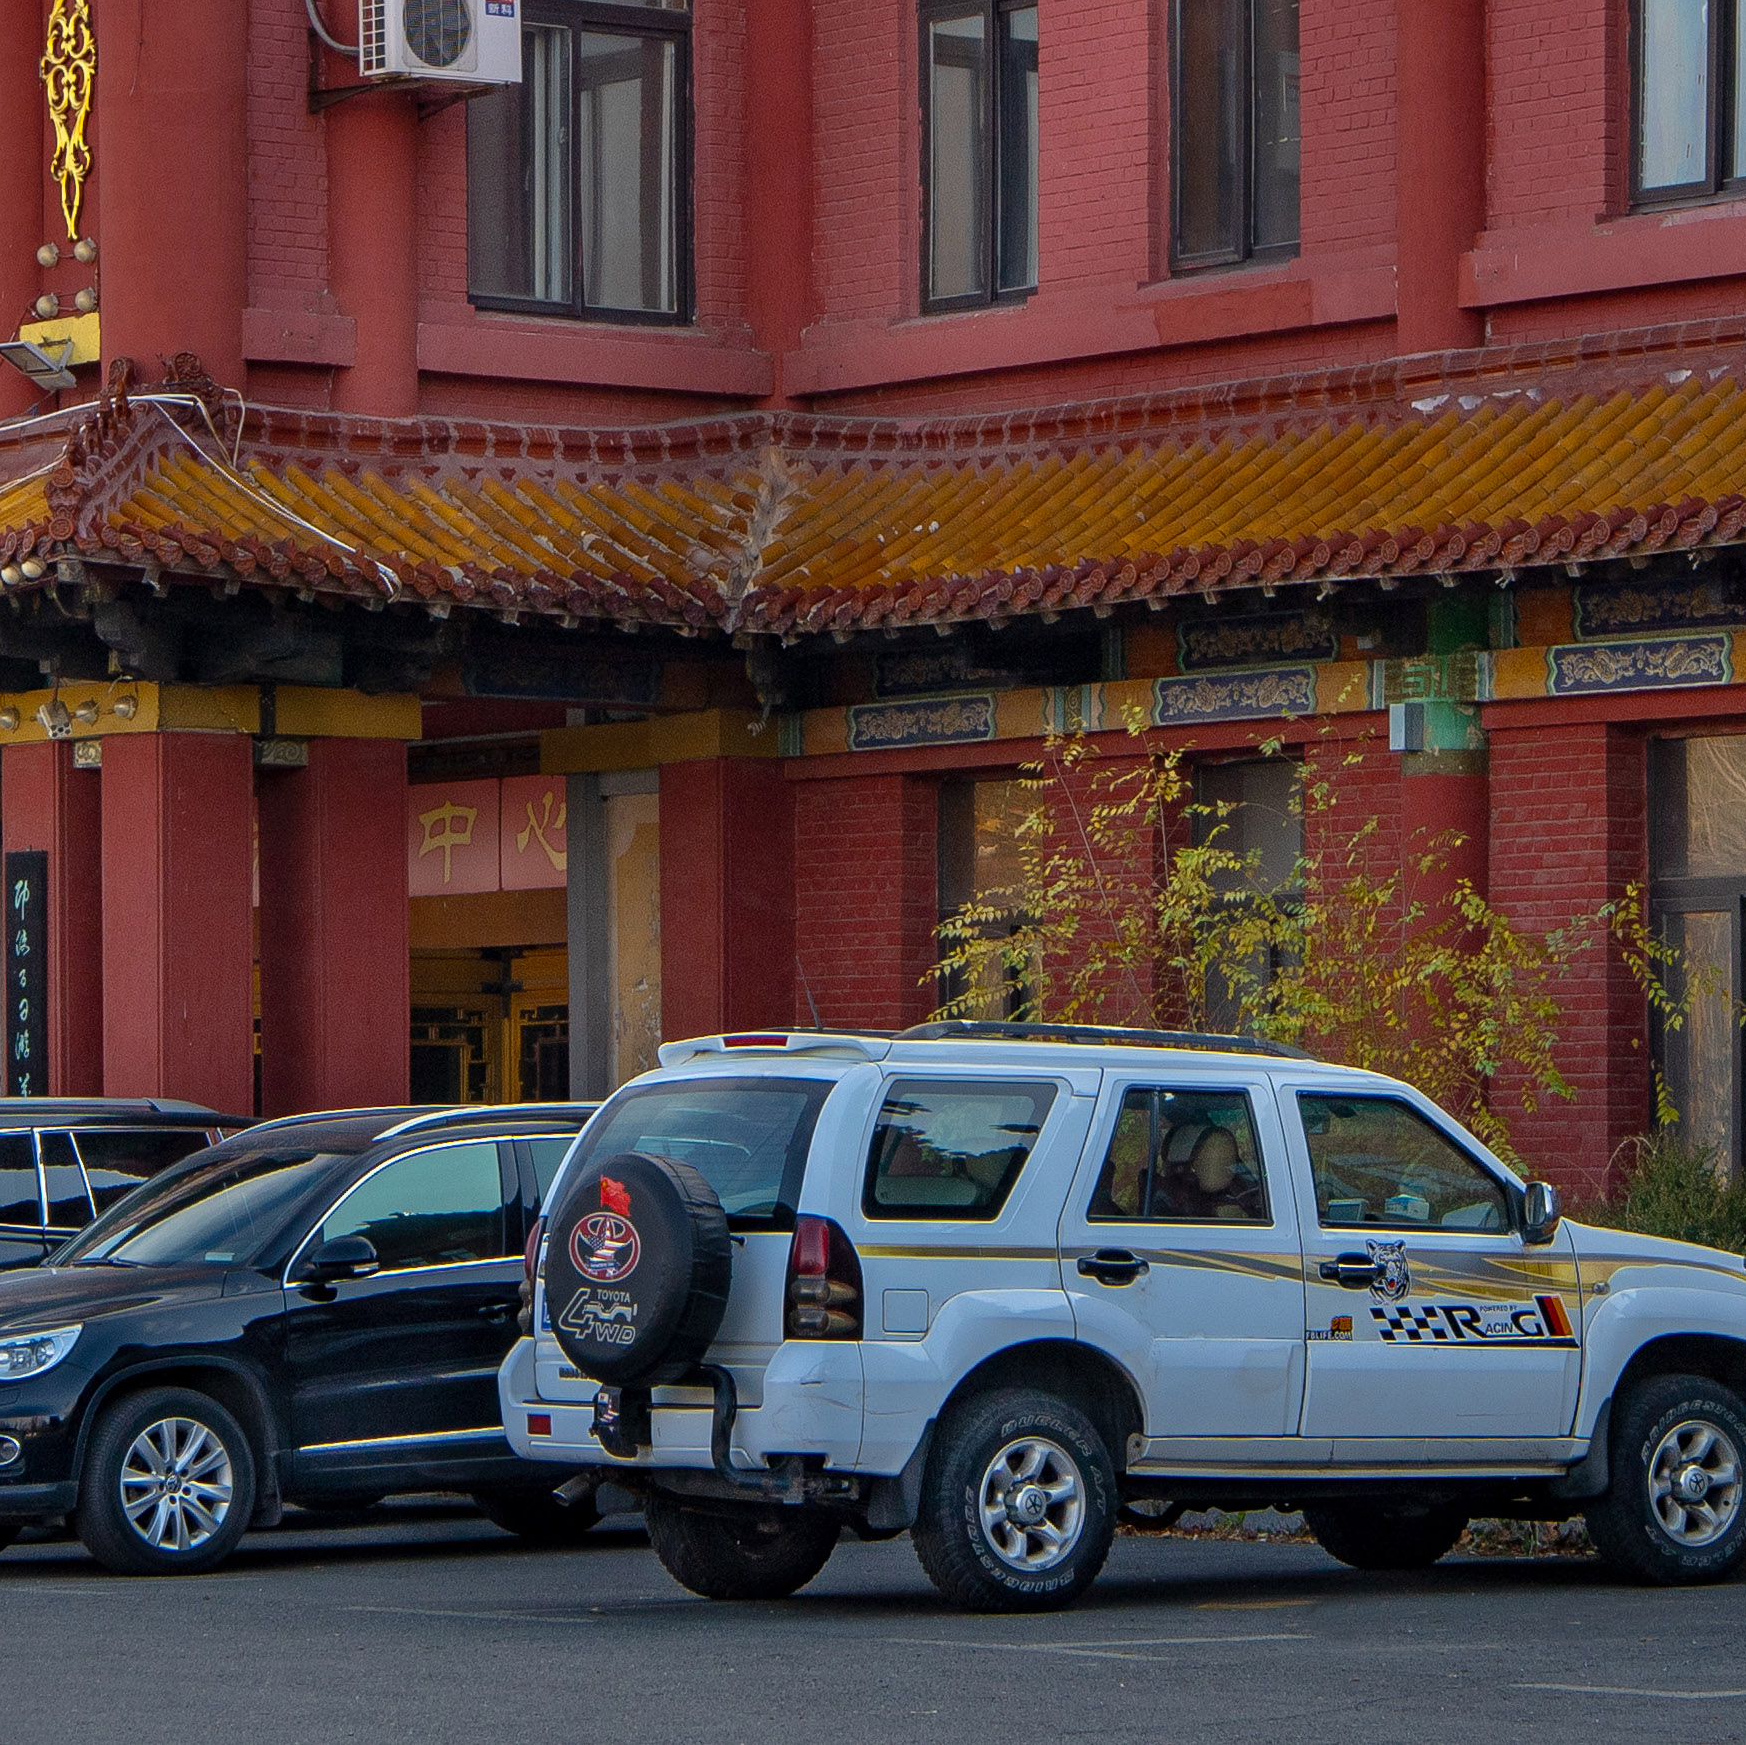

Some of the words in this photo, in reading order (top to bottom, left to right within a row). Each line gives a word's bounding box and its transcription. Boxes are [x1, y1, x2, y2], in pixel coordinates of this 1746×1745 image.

[418, 791, 567, 883] 中心
[596, 1288, 631, 1303] TOYOTA
[1306, 1330, 1352, 1341] FBLIFE.COM
